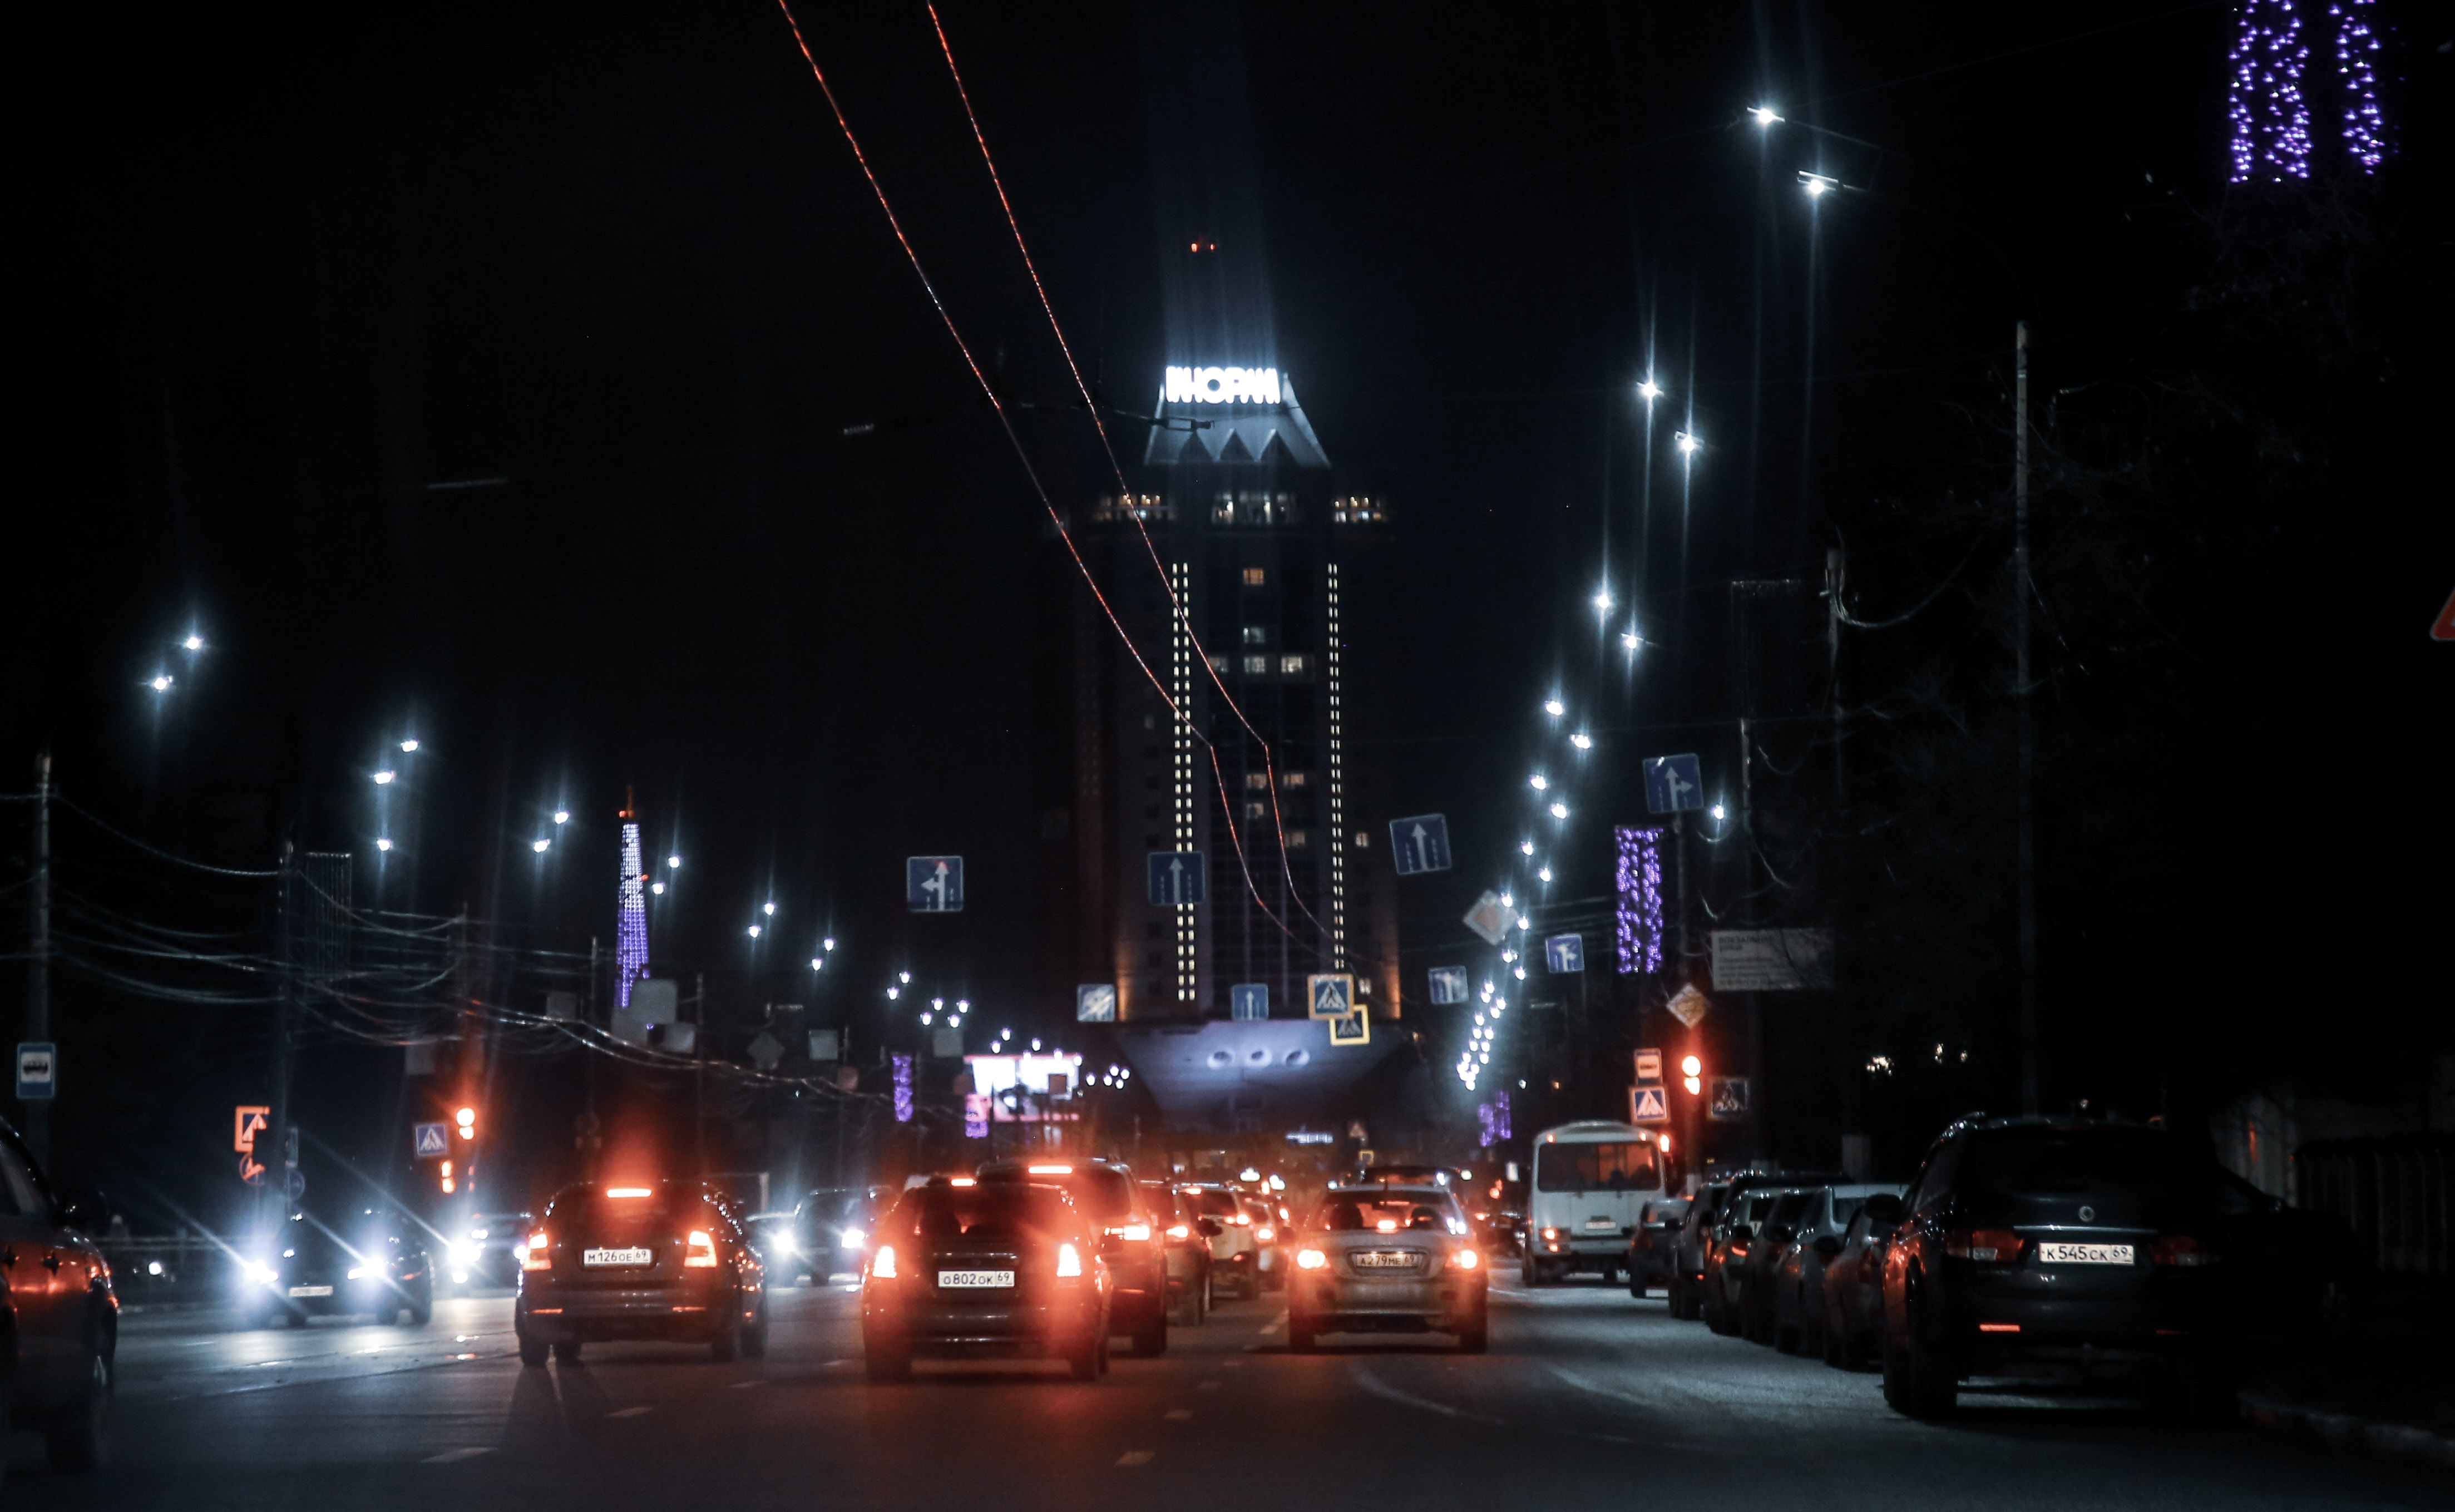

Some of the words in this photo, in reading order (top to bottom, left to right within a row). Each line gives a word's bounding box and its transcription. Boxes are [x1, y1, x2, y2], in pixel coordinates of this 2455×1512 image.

[588, 1252, 633, 1262] М126ОЕ
[635, 1251, 646, 1259] 69
[2047, 1246, 2108, 1261] К545СК
[2113, 1247, 2128, 1258] 69
[944, 1273, 994, 1285] О802ОК
[997, 1272, 1010, 1282] 69
